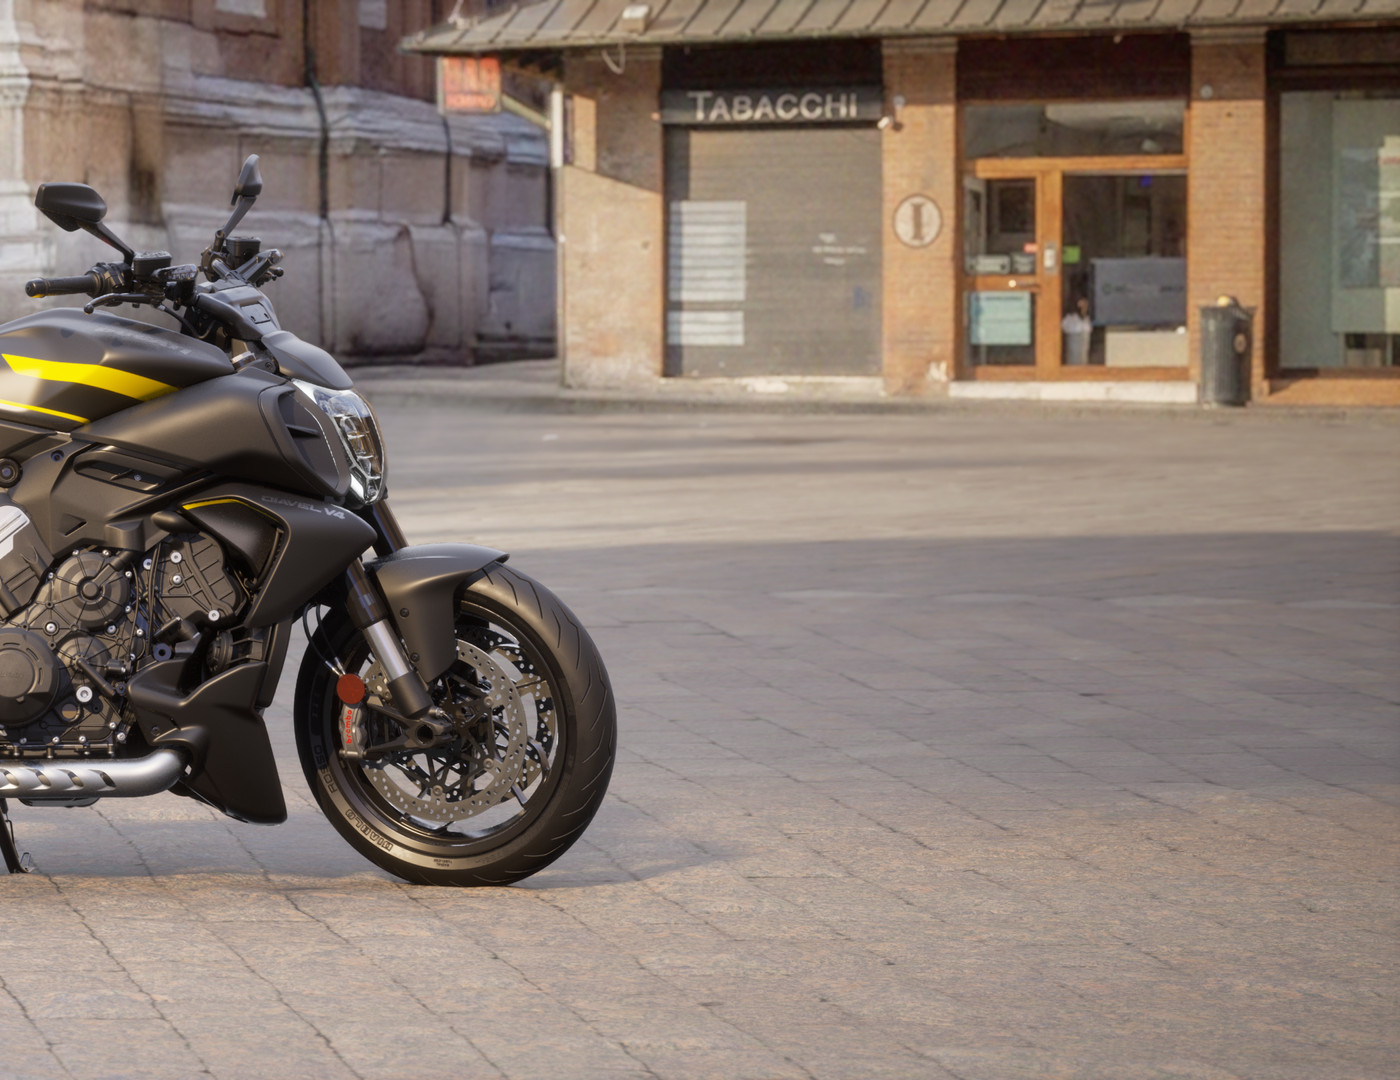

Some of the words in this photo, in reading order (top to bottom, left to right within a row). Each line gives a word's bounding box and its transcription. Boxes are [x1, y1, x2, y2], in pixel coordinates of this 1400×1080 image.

[686, 90, 858, 121] TABACCHI
[261, 495, 322, 513] DIAVEL
[323, 507, 346, 520] V4
[344, 709, 353, 745] brembo
[313, 744, 339, 794] ROSSO
[344, 808, 395, 852] DIABLO
